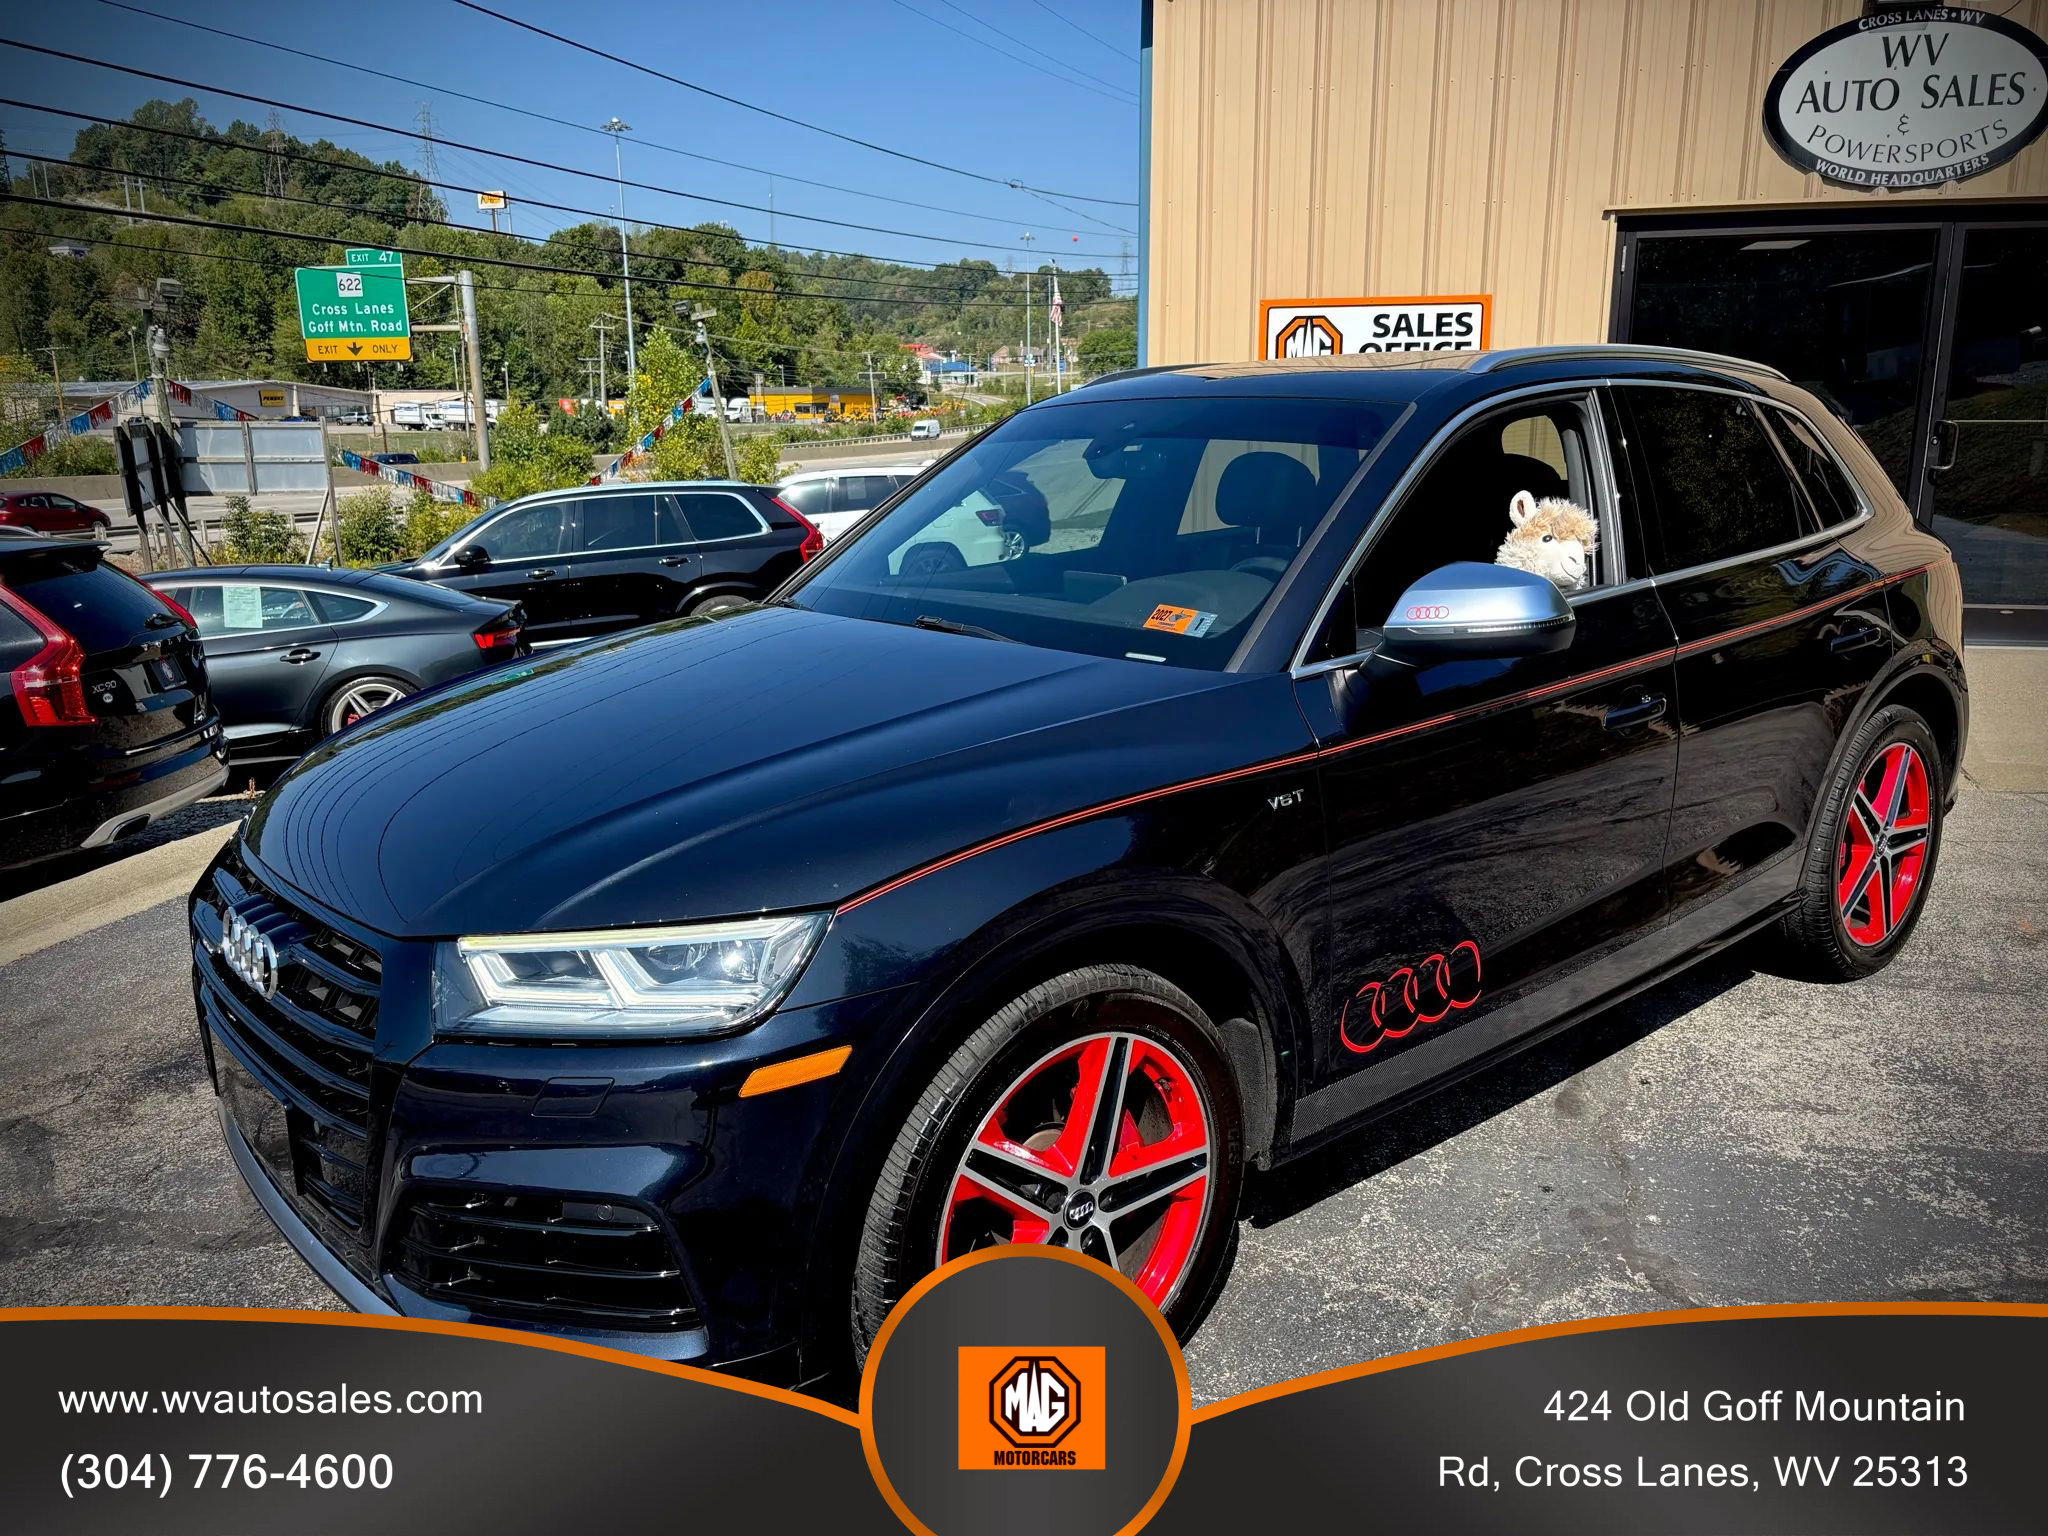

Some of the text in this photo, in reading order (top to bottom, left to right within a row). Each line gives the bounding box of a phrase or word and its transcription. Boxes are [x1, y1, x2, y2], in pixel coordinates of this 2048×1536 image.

[1858, 8, 1986, 31] CROSS LANES WV
[1881, 32, 1950, 69] WV
[1795, 71, 2027, 114] AUTO SALES
[1806, 118, 2009, 164] POWERSPORTS
[1815, 153, 1991, 187] WORLD HEADQUARTERS
[351, 251, 394, 263] EXIT 47
[338, 278, 362, 292] 622
[312, 302, 394, 316] Cross Lanes
[308, 319, 403, 333] Goff Mtn. Road
[1372, 312, 1474, 338] SALES
[318, 344, 398, 355] EXIT ONLY
[1151, 609, 1174, 622] 2027
[91, 680, 117, 694] XC90
